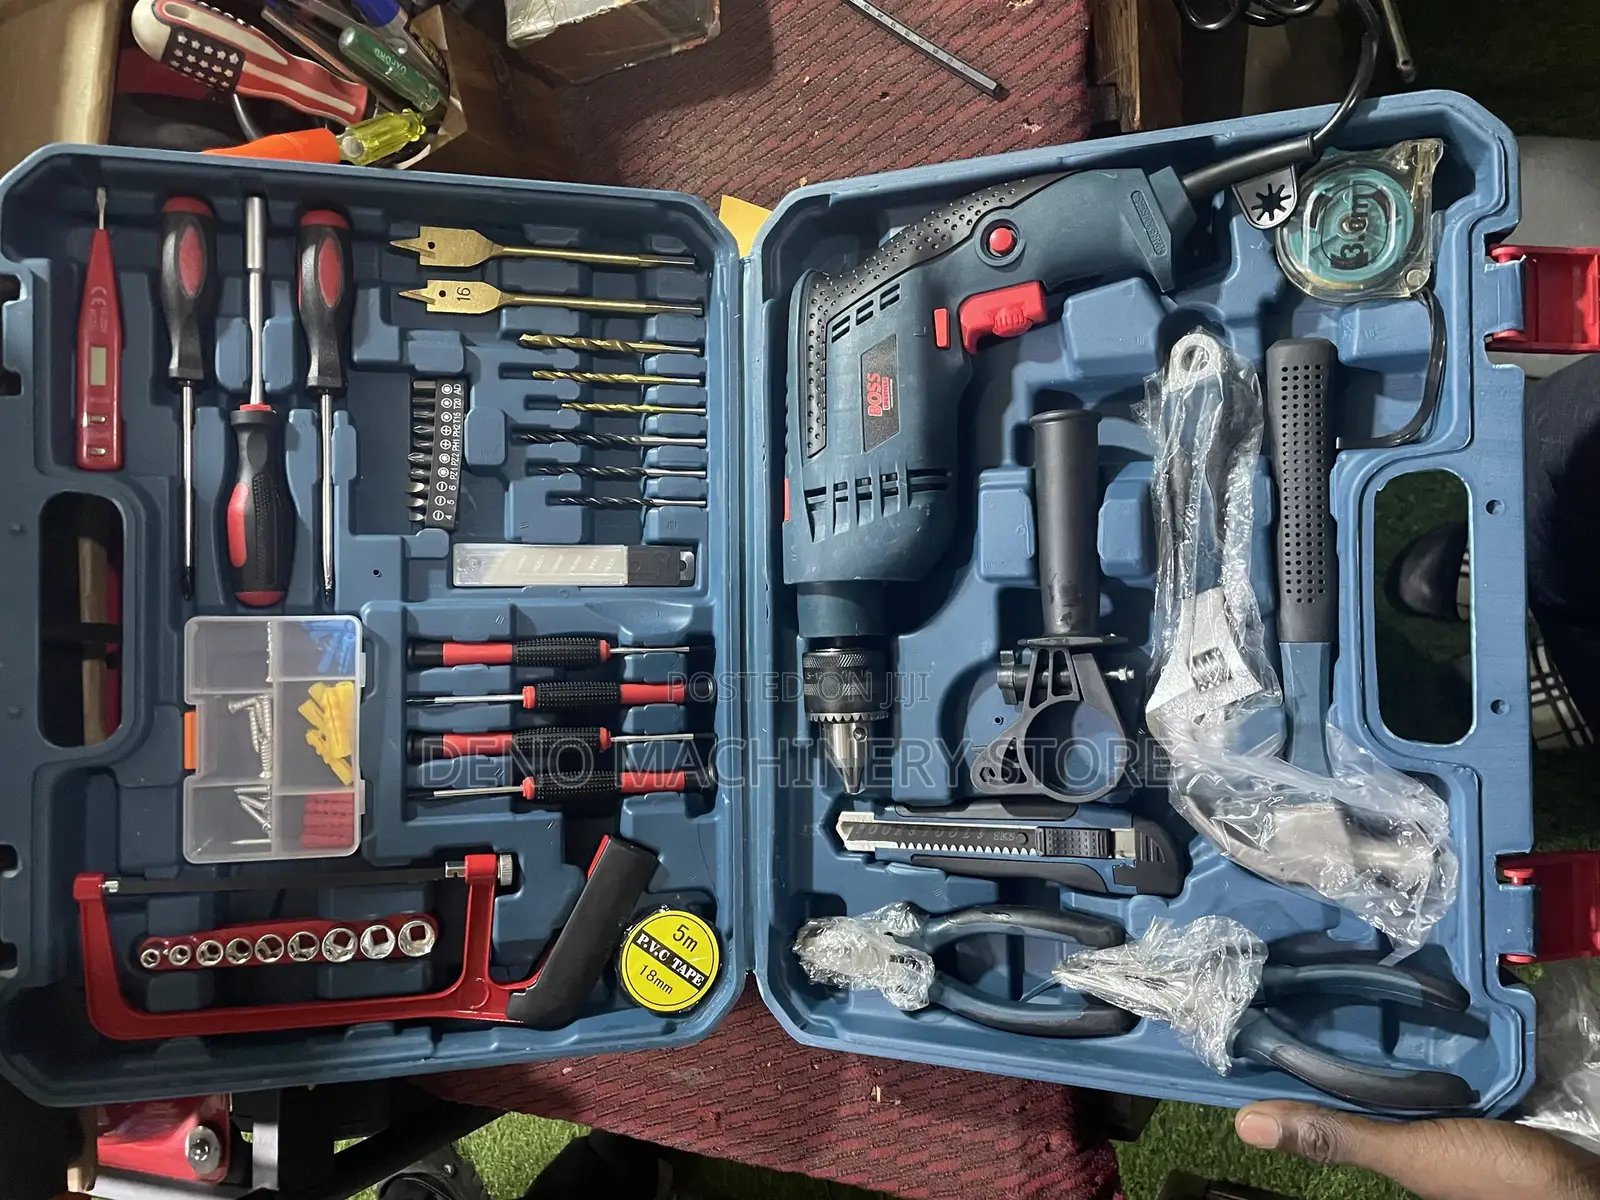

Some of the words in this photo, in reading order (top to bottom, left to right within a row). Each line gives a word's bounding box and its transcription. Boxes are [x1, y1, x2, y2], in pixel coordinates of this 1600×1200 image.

[373, 48, 407, 76] OXFORD
[456, 287, 471, 302] 16
[453, 383, 462, 395] AD
[867, 372, 883, 417] BOSS
[453, 398, 462, 409] T20
[452, 424, 461, 437] PH2
[452, 438, 461, 451] PH1
[451, 453, 460, 466] PZ2
[450, 467, 458, 480] PZ1
[672, 923, 698, 953] 5m
[636, 932, 671, 962] P.V.C
[671, 957, 705, 987] TAPE
[640, 965, 674, 995] 18mm
